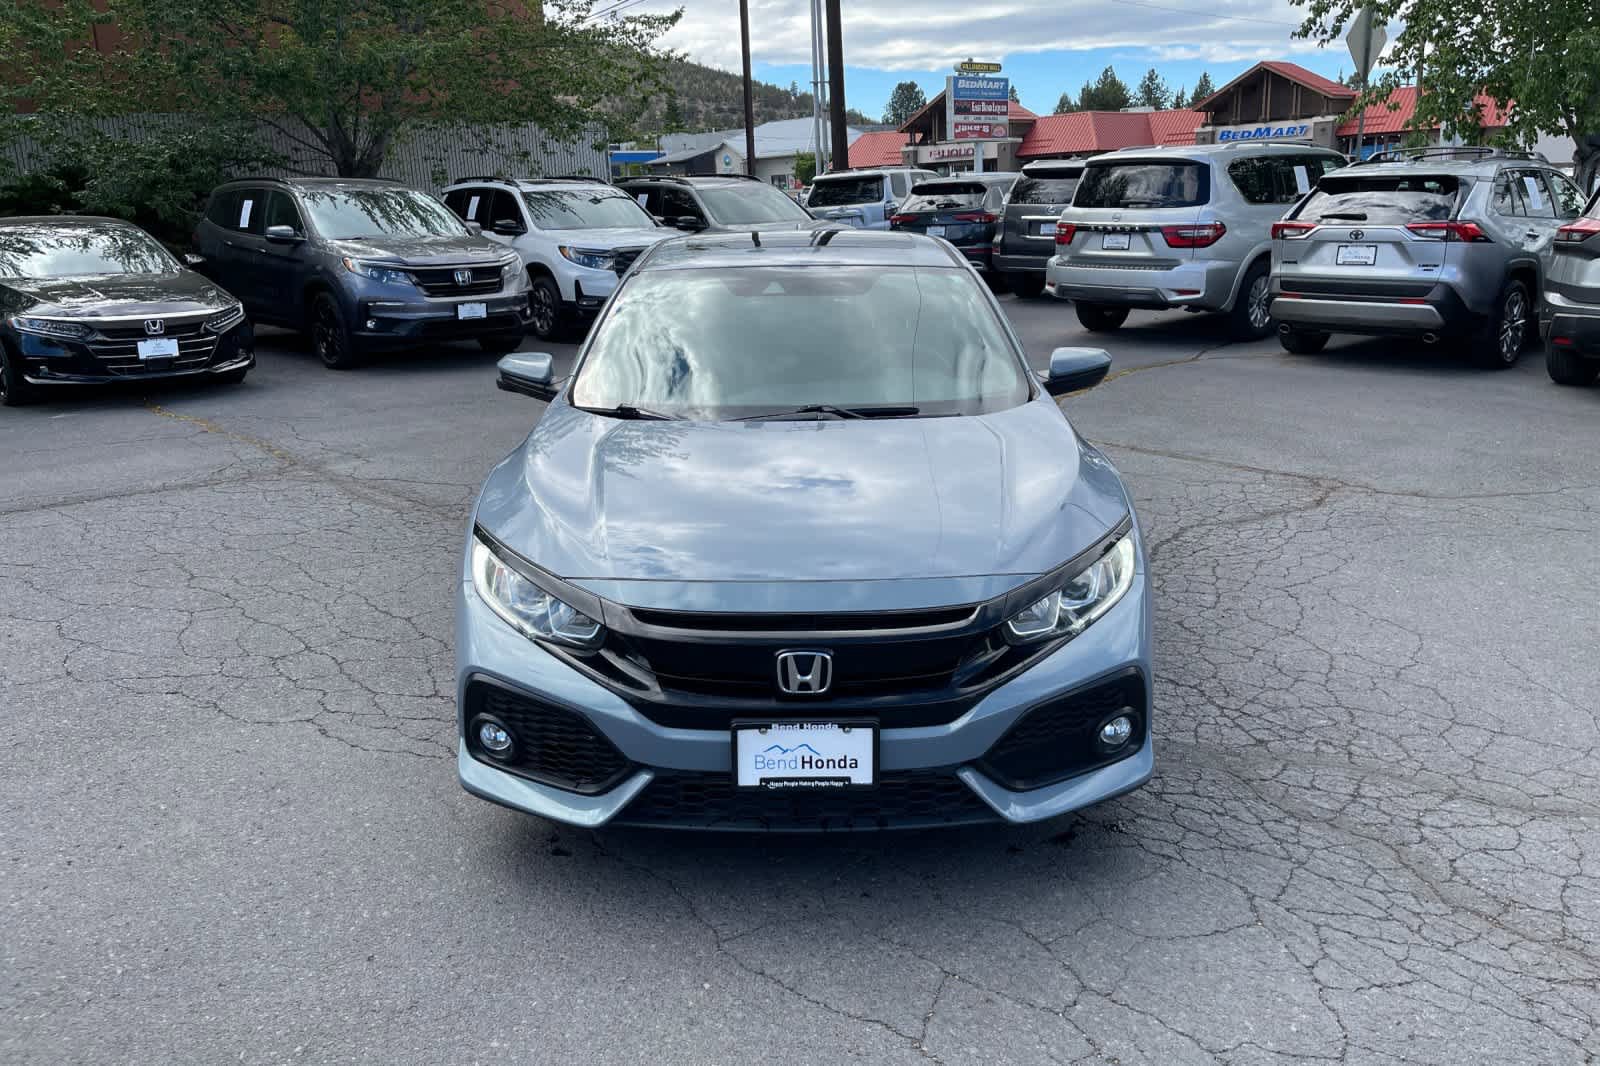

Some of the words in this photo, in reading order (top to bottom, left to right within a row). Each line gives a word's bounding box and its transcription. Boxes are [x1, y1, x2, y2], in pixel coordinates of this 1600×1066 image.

[957, 79, 1006, 89] BEDMART
[1218, 125, 1308, 141] BEDMART
[771, 723, 800, 731] Bend
[803, 723, 839, 731] Honda
[754, 755, 798, 770] Bend
[801, 754, 859, 770] Honda
